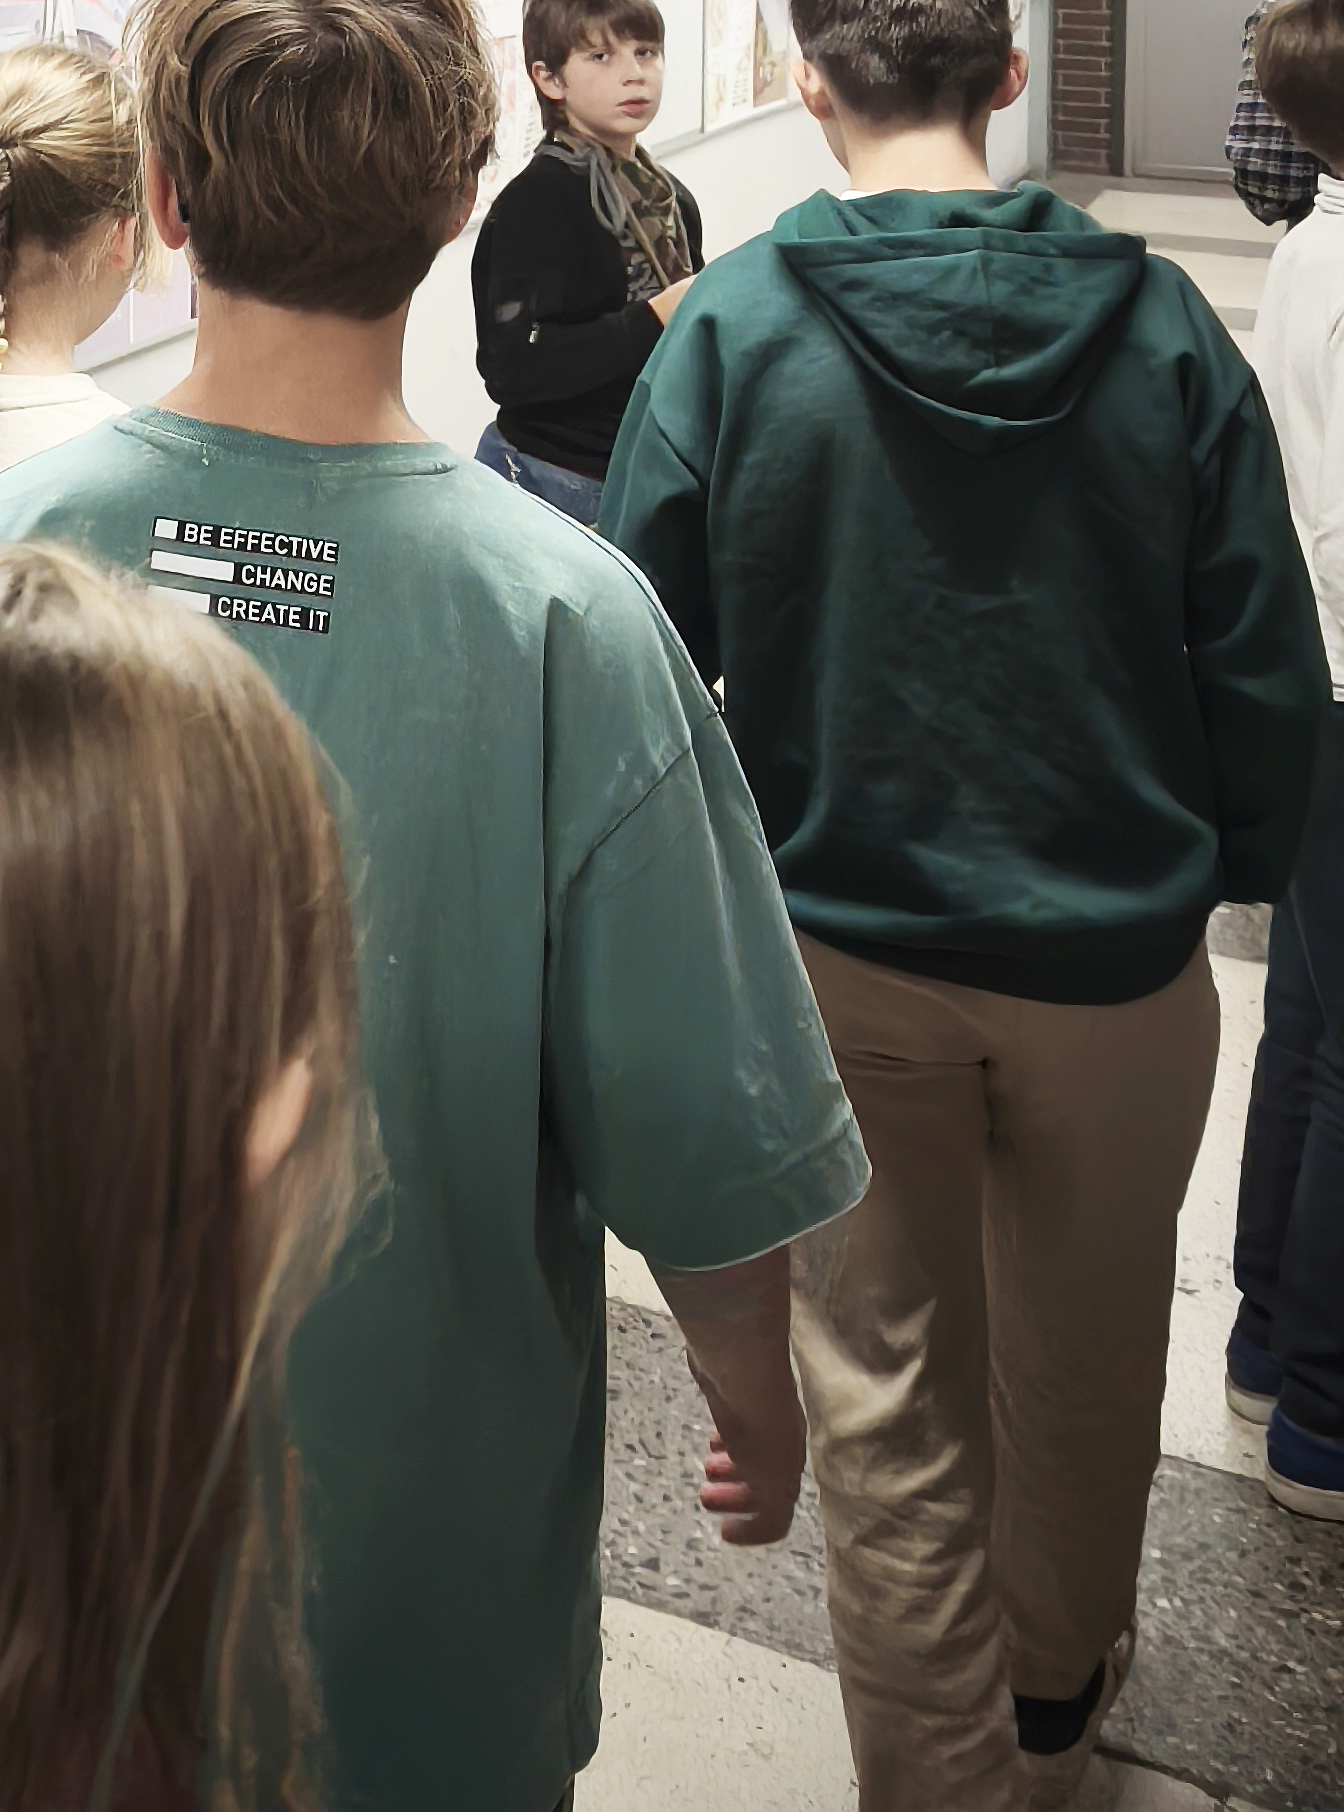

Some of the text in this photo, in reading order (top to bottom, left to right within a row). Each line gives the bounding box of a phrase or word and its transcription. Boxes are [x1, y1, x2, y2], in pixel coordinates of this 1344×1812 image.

[184, 522, 338, 562] BE EFFECTIVE
[241, 564, 334, 596] CHANGE
[217, 597, 328, 631] CREATE IT
